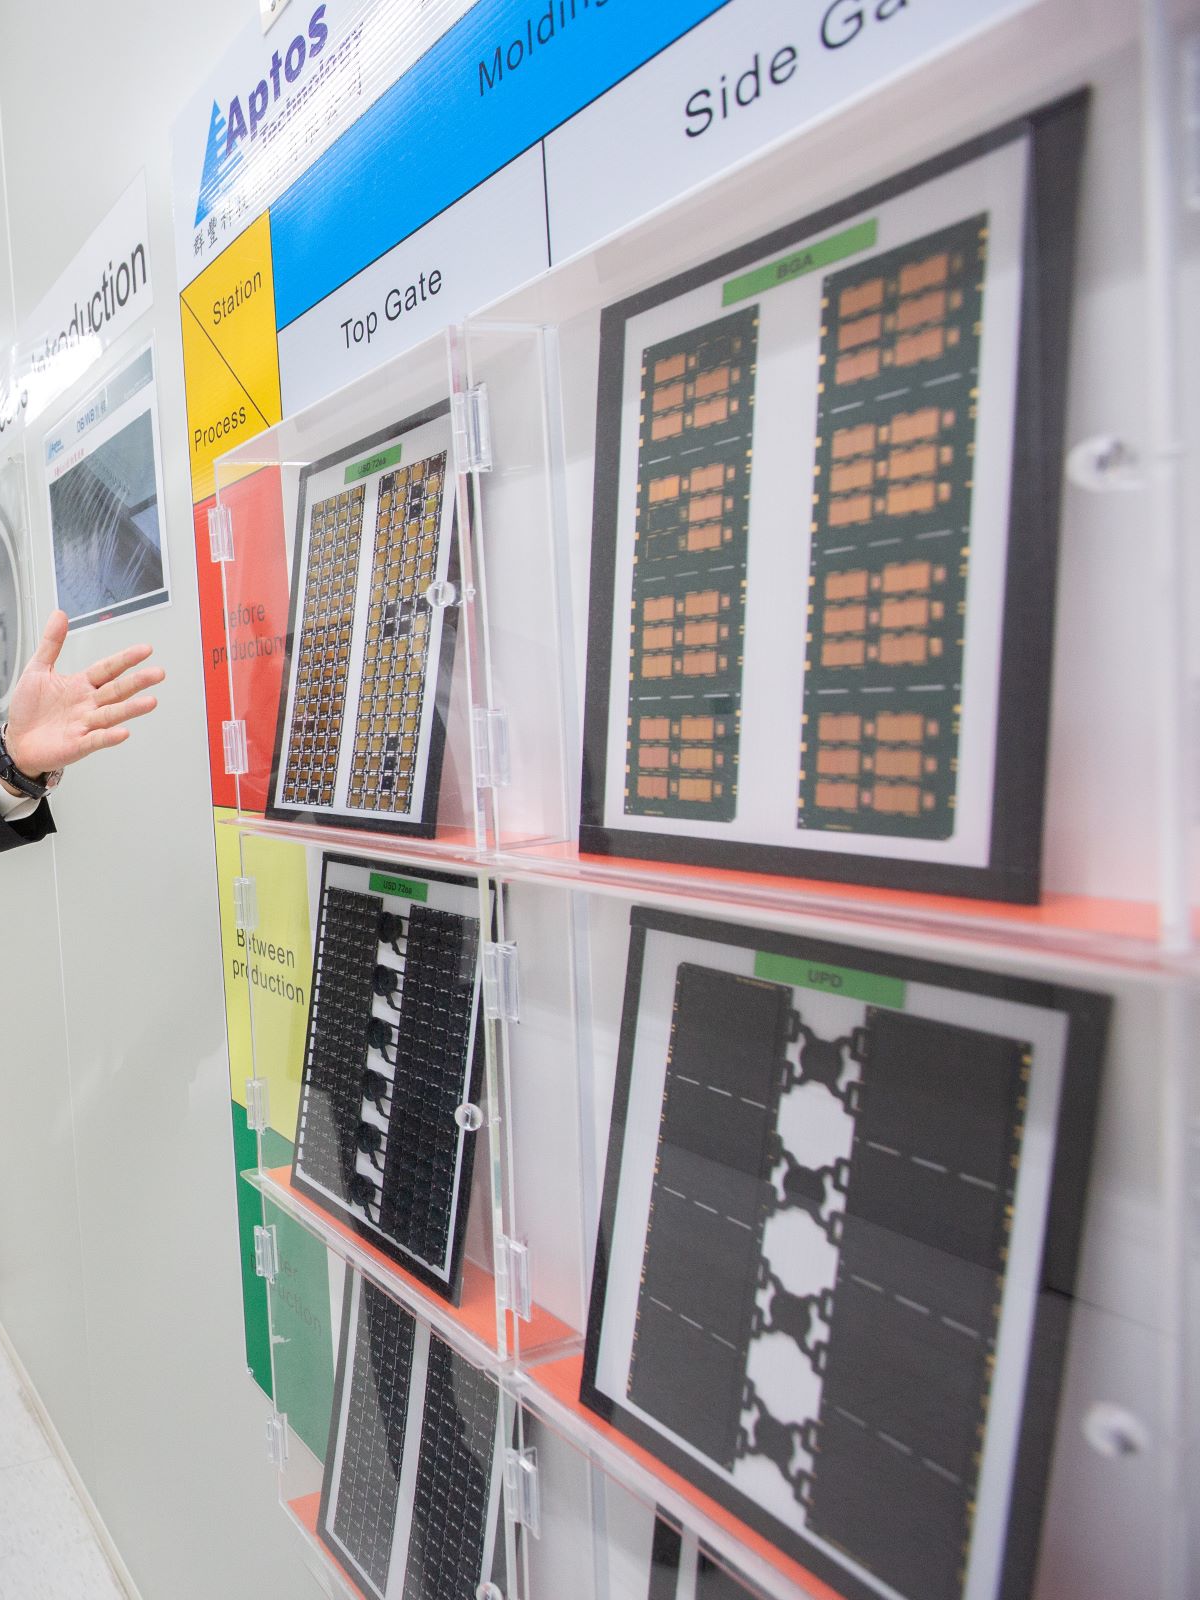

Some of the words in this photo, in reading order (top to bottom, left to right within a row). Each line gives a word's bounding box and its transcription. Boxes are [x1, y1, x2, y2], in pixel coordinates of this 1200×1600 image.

[225, 3, 329, 157] Aptos
[684, 45, 798, 138] Side
[213, 271, 262, 326] Station
[340, 312, 378, 349] Top
[384, 269, 443, 322] Gate
[194, 405, 247, 453] Process
[222, 602, 266, 630] efore
[212, 634, 283, 670] prduction
